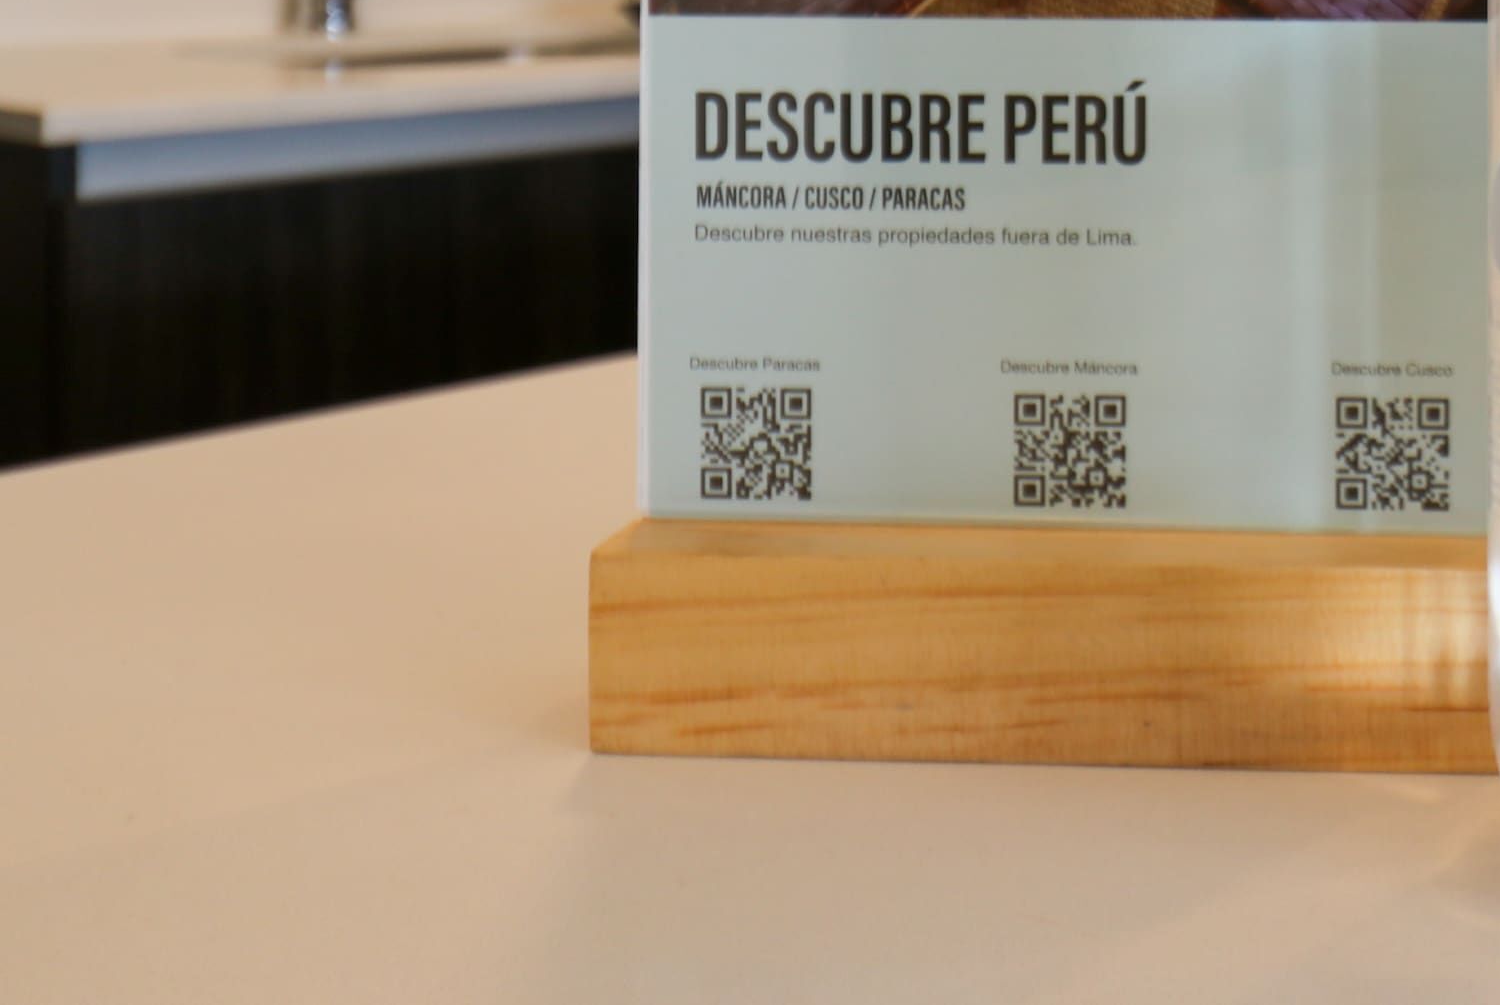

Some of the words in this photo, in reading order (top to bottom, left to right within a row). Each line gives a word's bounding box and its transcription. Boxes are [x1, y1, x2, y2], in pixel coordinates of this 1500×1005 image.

[695, 91, 987, 163] DESCUBRE
[1003, 79, 1148, 166] PERÚ
[696, 184, 788, 211] MÁNCORA
[804, 187, 865, 211] CUSCO
[881, 187, 967, 212] PARACAS
[694, 224, 785, 244] Descubre
[791, 226, 873, 244] nuestras
[877, 226, 996, 248] propiedades
[1001, 227, 1050, 246] fuera
[1055, 227, 1080, 246] de
[1086, 227, 1138, 247] Lima.
[689, 356, 758, 372] Descubre
[762, 357, 821, 373] Paracas
[1000, 358, 1070, 375] Descubre
[1331, 361, 1401, 377] Descubre
[1405, 362, 1455, 378] Cusco
